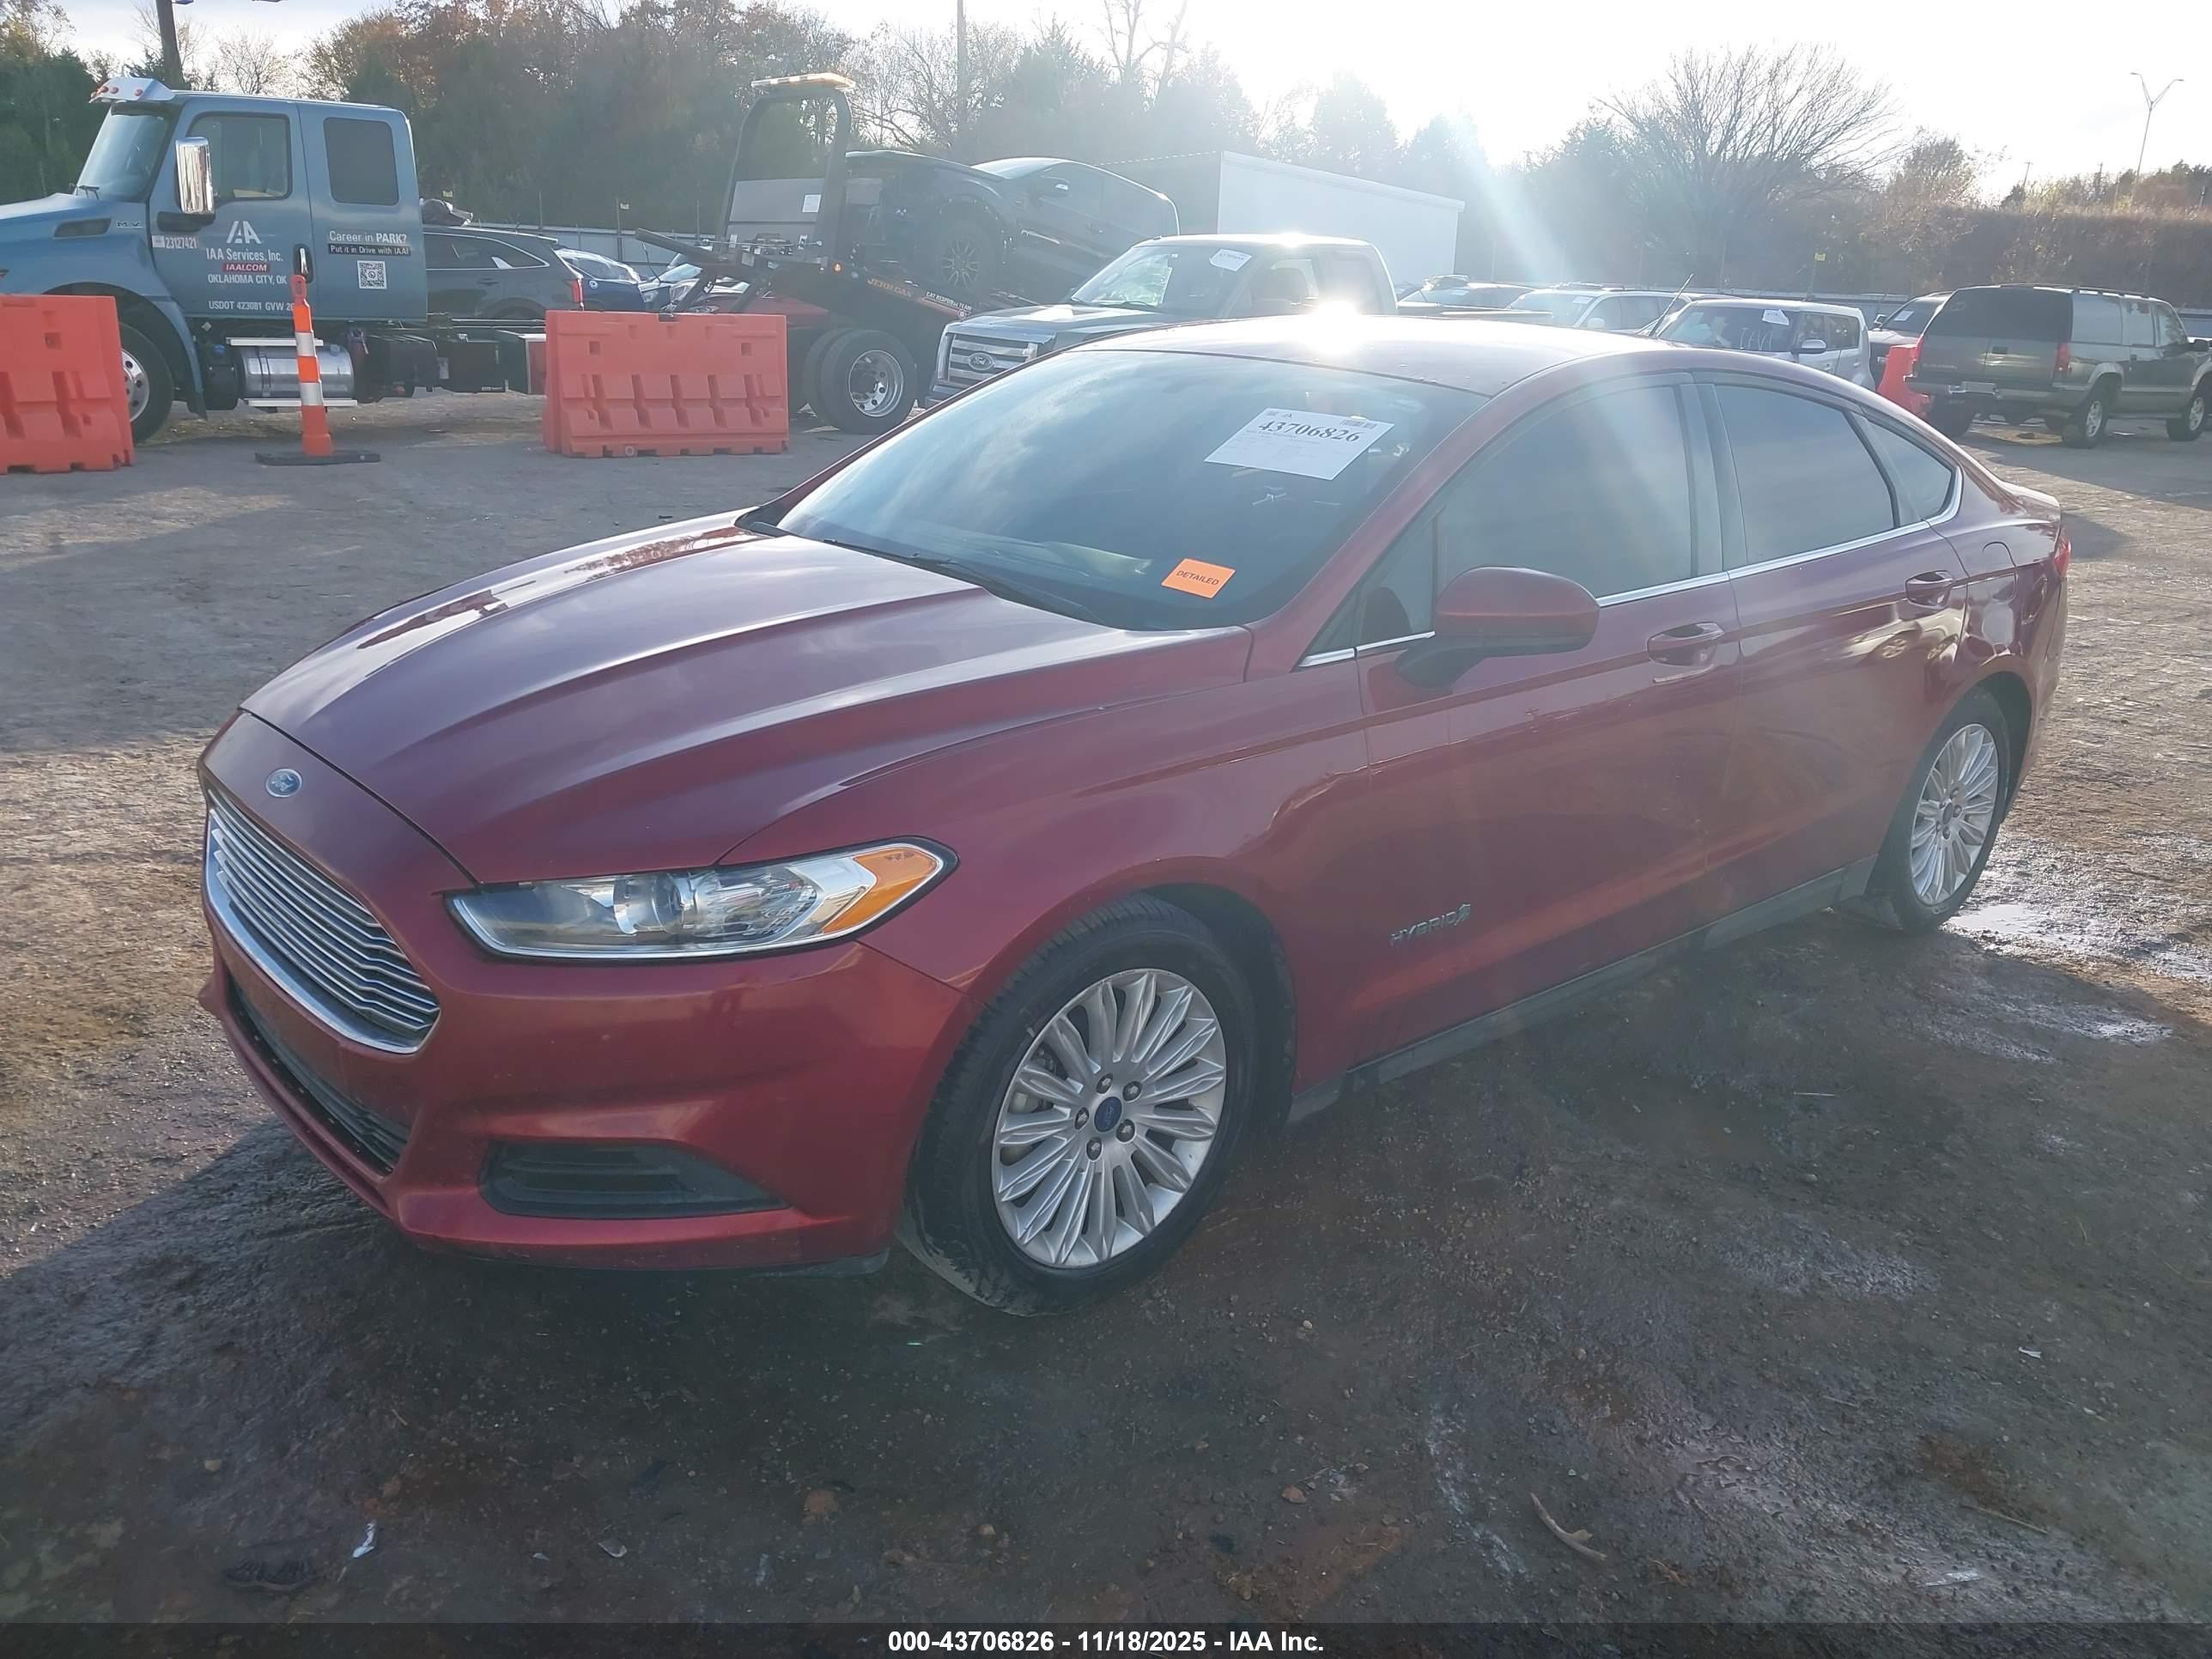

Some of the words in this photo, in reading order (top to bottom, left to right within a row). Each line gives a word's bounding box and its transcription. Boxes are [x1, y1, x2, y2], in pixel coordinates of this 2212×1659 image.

[166, 236, 198, 249] 23127421
[329, 230, 362, 242] Career
[365, 232, 374, 242] in
[376, 233, 407, 244] PARK?
[206, 247, 224, 259] IAA
[226, 247, 267, 262] Services,
[268, 249, 283, 261] Inc.
[359, 246, 376, 254] Drive
[378, 246, 392, 255] with
[208, 274, 254, 284] OKLAHOMA
[256, 275, 274, 285] CITY,
[276, 276, 288, 285] OK
[209, 301, 234, 310] USDOT
[236, 301, 262, 311] 423081
[265, 302, 284, 311] GVW
[1259, 421, 1363, 442] 43706826
[1176, 570, 1219, 586] DETAILED
